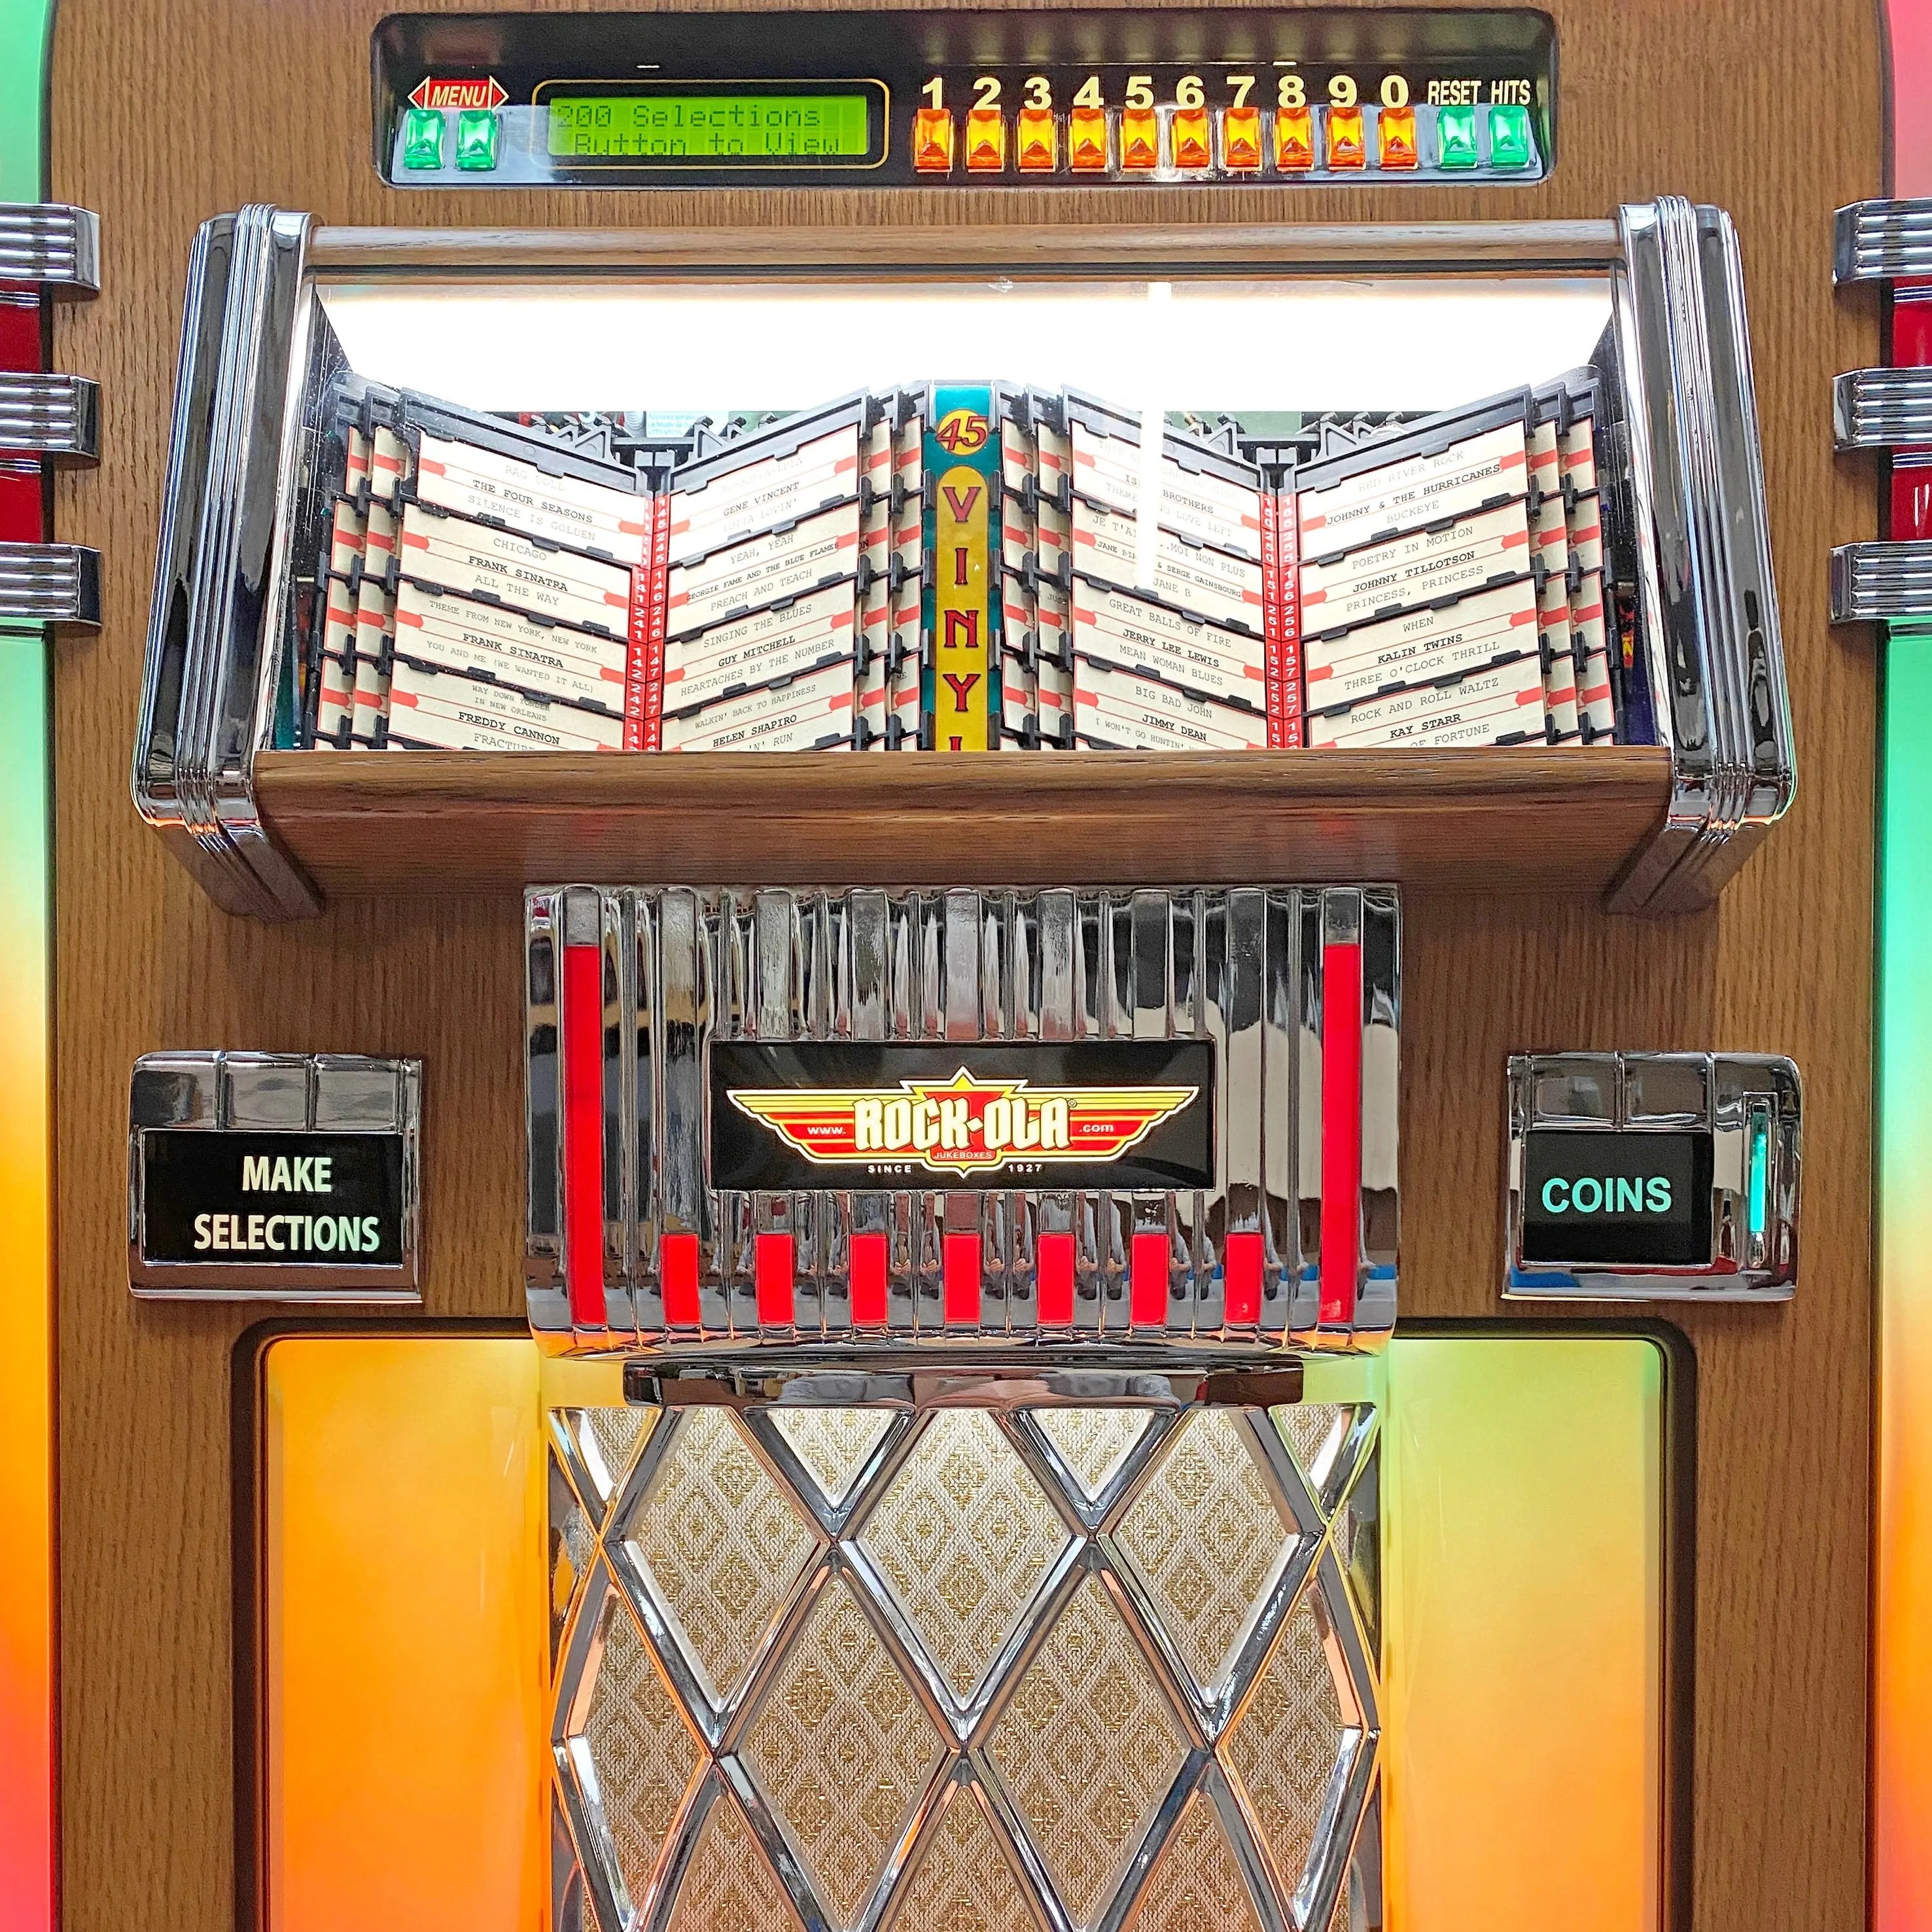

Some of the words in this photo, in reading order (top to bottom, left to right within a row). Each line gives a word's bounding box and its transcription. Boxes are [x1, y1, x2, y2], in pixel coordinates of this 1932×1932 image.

[430, 86, 486, 106] MENU
[921, 77, 943, 109] 1
[973, 78, 1001, 110] 2
[1024, 78, 1052, 109] 3
[1073, 77, 1104, 108] 4
[1125, 77, 1154, 108] 5
[1175, 77, 1204, 109] 6
[1226, 76, 1257, 108] 7
[1278, 77, 1306, 109] 8
[1329, 75, 1358, 108] 9
[1380, 75, 1409, 107] 0
[1428, 80, 1481, 106] RESET
[1490, 80, 1531, 106] HITS
[557, 105, 611, 127] 200
[633, 105, 820, 127] Selections
[575, 133, 686, 155] Button
[709, 132, 743, 154] to
[765, 132, 839, 155] View
[936, 415, 988, 451] 45
[1359, 477, 1379, 491] RED
[1388, 463, 1426, 482] RIVER
[1433, 450, 1464, 468] ROCK
[473, 480, 495, 493] THE
[504, 488, 533, 506] FOUR
[541, 502, 593, 523] SEASONS
[724, 501, 748, 516] GENE
[754, 482, 799, 504] VINCENT
[1163, 489, 1214, 514] BROTHERS
[1327, 505, 1371, 525] JOHNNY
[1393, 491, 1415, 505] THE
[1423, 464, 1500, 495] HURRICANES
[1387, 501, 1439, 523] BUCKEYE
[468, 495, 521, 518] SILENCE
[530, 514, 543, 525] IS
[551, 521, 595, 541] GOLDEN
[1176, 510, 1201, 526] LOVE
[1208, 521, 1231, 537] LEFT
[493, 538, 547, 561] CHICAGO
[731, 549, 759, 565] YEAH,
[768, 535, 794, 551] YEAH
[1093, 515, 1106, 527] JE
[1196, 552, 1214, 567] NON
[1221, 561, 1245, 578] PLUS
[1352, 549, 1396, 569] POETRY
[1405, 543, 1419, 554] IN
[1426, 526, 1473, 547] MOTION
[469, 555, 508, 573] FRANK
[515, 569, 568, 591] SINATRA
[686, 585, 718, 601] GEORGIE
[724, 577, 742, 588] FAME
[746, 570, 762, 580] AND
[765, 563, 780, 573] THE
[785, 555, 804, 567] BLUE
[809, 542, 839, 558] FLAMES
[1098, 541, 1117, 553] JANE
[1167, 565, 1191, 579] SERGE
[1195, 576, 1241, 598] GAINSBOURG
[1153, 578, 1178, 593] JANE
[1353, 573, 1397, 593] JOHNNY
[1405, 551, 1475, 577] TILLOTSON
[475, 575, 499, 588] ALL
[506, 584, 529, 597] THE
[536, 591, 559, 606] WAY
[711, 591, 747, 611] PREACH
[754, 582, 773, 597] AND
[780, 569, 813, 587] TEACH
[1346, 588, 1411, 612] PRINCESS,
[1422, 565, 1483, 590] PRINCESS
[430, 600, 459, 614] THEME
[466, 609, 489, 622] FROM
[495, 617, 512, 629] NEW
[518, 624, 544, 639] YORK,
[552, 635, 570, 646] NEW
[574, 641, 597, 654] YORK
[703, 627, 747, 648] SINGING
[754, 618, 773, 631] THE
[779, 605, 812, 623] BLUES
[1109, 599, 1142, 617] GREAT
[1149, 612, 1180, 630] BALLS
[1187, 625, 1201, 637] OF
[1207, 632, 1231, 648] FIRE
[1403, 616, 1434, 633] WHEN
[463, 633, 502, 650] FRANK
[510, 646, 564, 669] SINATRA
[718, 654, 737, 667] GUY
[743, 636, 796, 659] MITCHELL
[1119, 644, 1146, 661] MEAN
[1153, 655, 1185, 673] WOMAN
[1191, 669, 1223, 686] BLUES
[1123, 629, 1155, 646] JERRY
[1162, 641, 1182, 654] LEE
[1187, 650, 1220, 667] LEWIS
[1344, 673, 1382, 690] THREE
[1390, 656, 1445, 678] O'CLOCK
[1452, 641, 1500, 661] THRILL
[1378, 646, 1416, 664] KALIN
[1424, 633, 1463, 650] TWINS
[427, 640, 445, 652] YOU
[450, 647, 469, 659] AND
[474, 654, 487, 663] ME
[494, 658, 510, 671] (WE
[515, 663, 550, 681] WANTED
[555, 675, 568, 686] IT
[572, 680, 594, 694] ALL)
[680, 669, 743, 697] HEARTACHES
[750, 662, 762, 675] BY
[769, 655, 788, 668] THE
[795, 639, 834, 659] NUMBER
[472, 684, 489, 694] WAY
[494, 691, 514, 701] DOWN
[520, 697, 550, 711] YONDER
[490, 701, 506, 711] NEW
[511, 707, 547, 722] ORLEANS
[695, 712, 728, 729] WALKIN'
[733, 705, 752, 717] BACK
[756, 701, 767, 710] TO
[771, 684, 816, 705] HAPPINESS
[1135, 686, 1156, 699] BIG
[1162, 694, 1182, 708] BAD
[1187, 702, 1212, 718] JOHN
[1351, 708, 1382, 724] ROCK
[1389, 700, 1413, 714] AND
[1420, 691, 1451, 707] ROLL
[1459, 677, 1499, 695] WALTZ
[459, 711, 506, 731] FREDDY
[514, 726, 560, 745] CANNON
[712, 730, 745, 748] HELEN
[751, 714, 797, 735] SHAPIRO
[773, 732, 793, 746] RUN
[1105, 721, 1131, 734] WON'T
[1135, 730, 1146, 739] GO
[1151, 735, 1184, 749] HUNTIN'
[1142, 714, 1175, 731] JIMMY
[1181, 726, 1206, 741] DEAN
[1390, 726, 1413, 738] KAY
[1422, 714, 1461, 730] STARR
[1435, 724, 1490, 745] FORTUNE
[807, 1125, 847, 1135] www.
[1079, 1122, 1115, 1134] .com
[868, 1165, 912, 1174] SINCE
[1008, 1163, 1042, 1173] 1927
[933, 1150, 993, 1160] JUKEBOXES
[242, 1155, 333, 1193] MAKE
[1542, 1177, 1672, 1213] COINS
[194, 1214, 380, 1252] SELECTIONS
